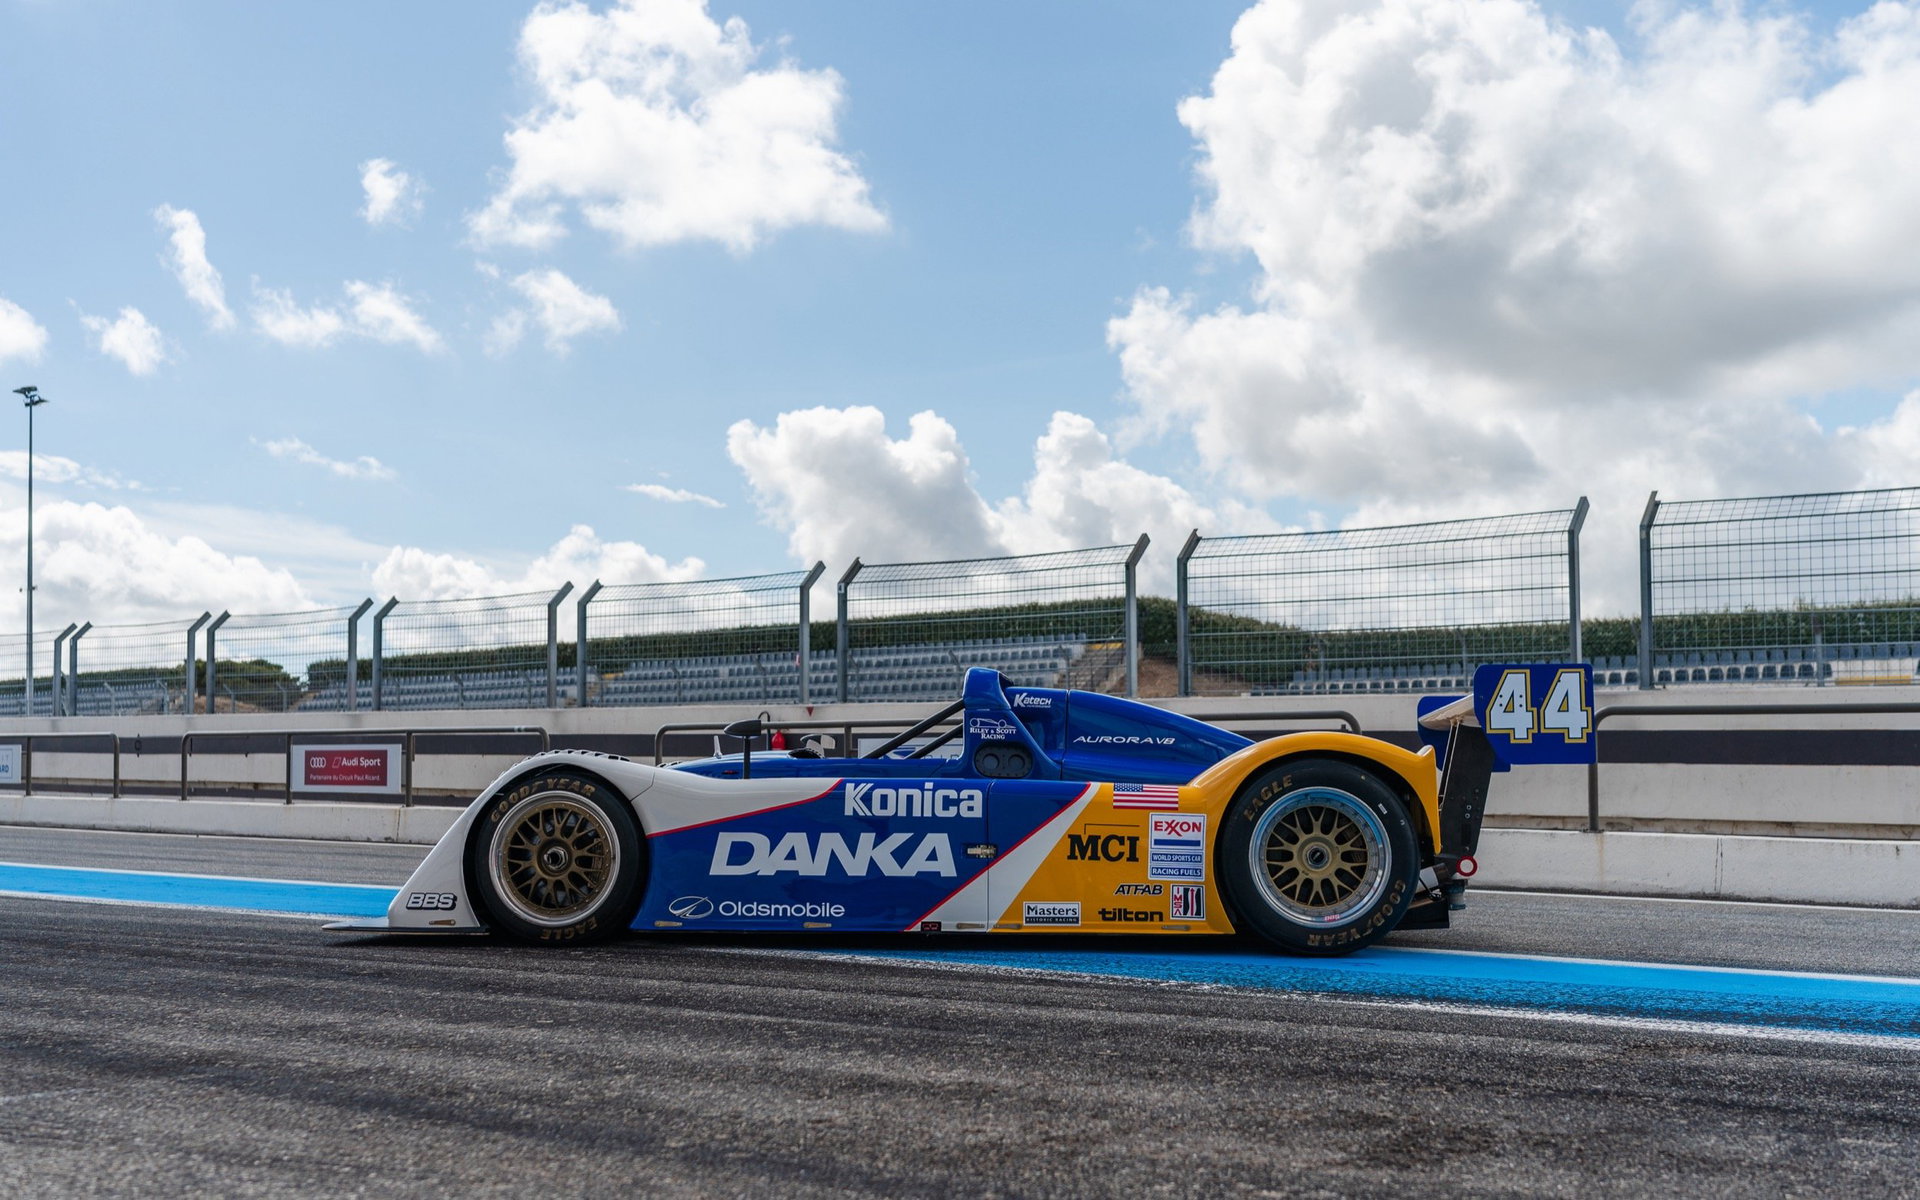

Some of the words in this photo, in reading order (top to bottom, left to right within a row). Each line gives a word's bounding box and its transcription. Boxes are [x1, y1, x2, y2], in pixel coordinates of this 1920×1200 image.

[1485, 668, 1593, 744] 44
[1073, 735, 1154, 745] AURORA
[1156, 737, 1176, 745] V8
[341, 756, 359, 767] Audi
[360, 756, 381, 768] Sport
[844, 781, 983, 818] Konica
[1243, 773, 1293, 822] EAGLE
[1154, 820, 1202, 837] EXXON
[709, 831, 957, 877] DANKA
[1067, 834, 1140, 862] MCI
[1114, 884, 1163, 896] ATFAB
[406, 893, 457, 910] BBS
[719, 900, 845, 918] Oldsmobile
[1026, 904, 1078, 916] Masters
[1173, 887, 1183, 915] IMSA
[1098, 908, 1164, 922] tilton
[540, 915, 598, 940] EAGLE
